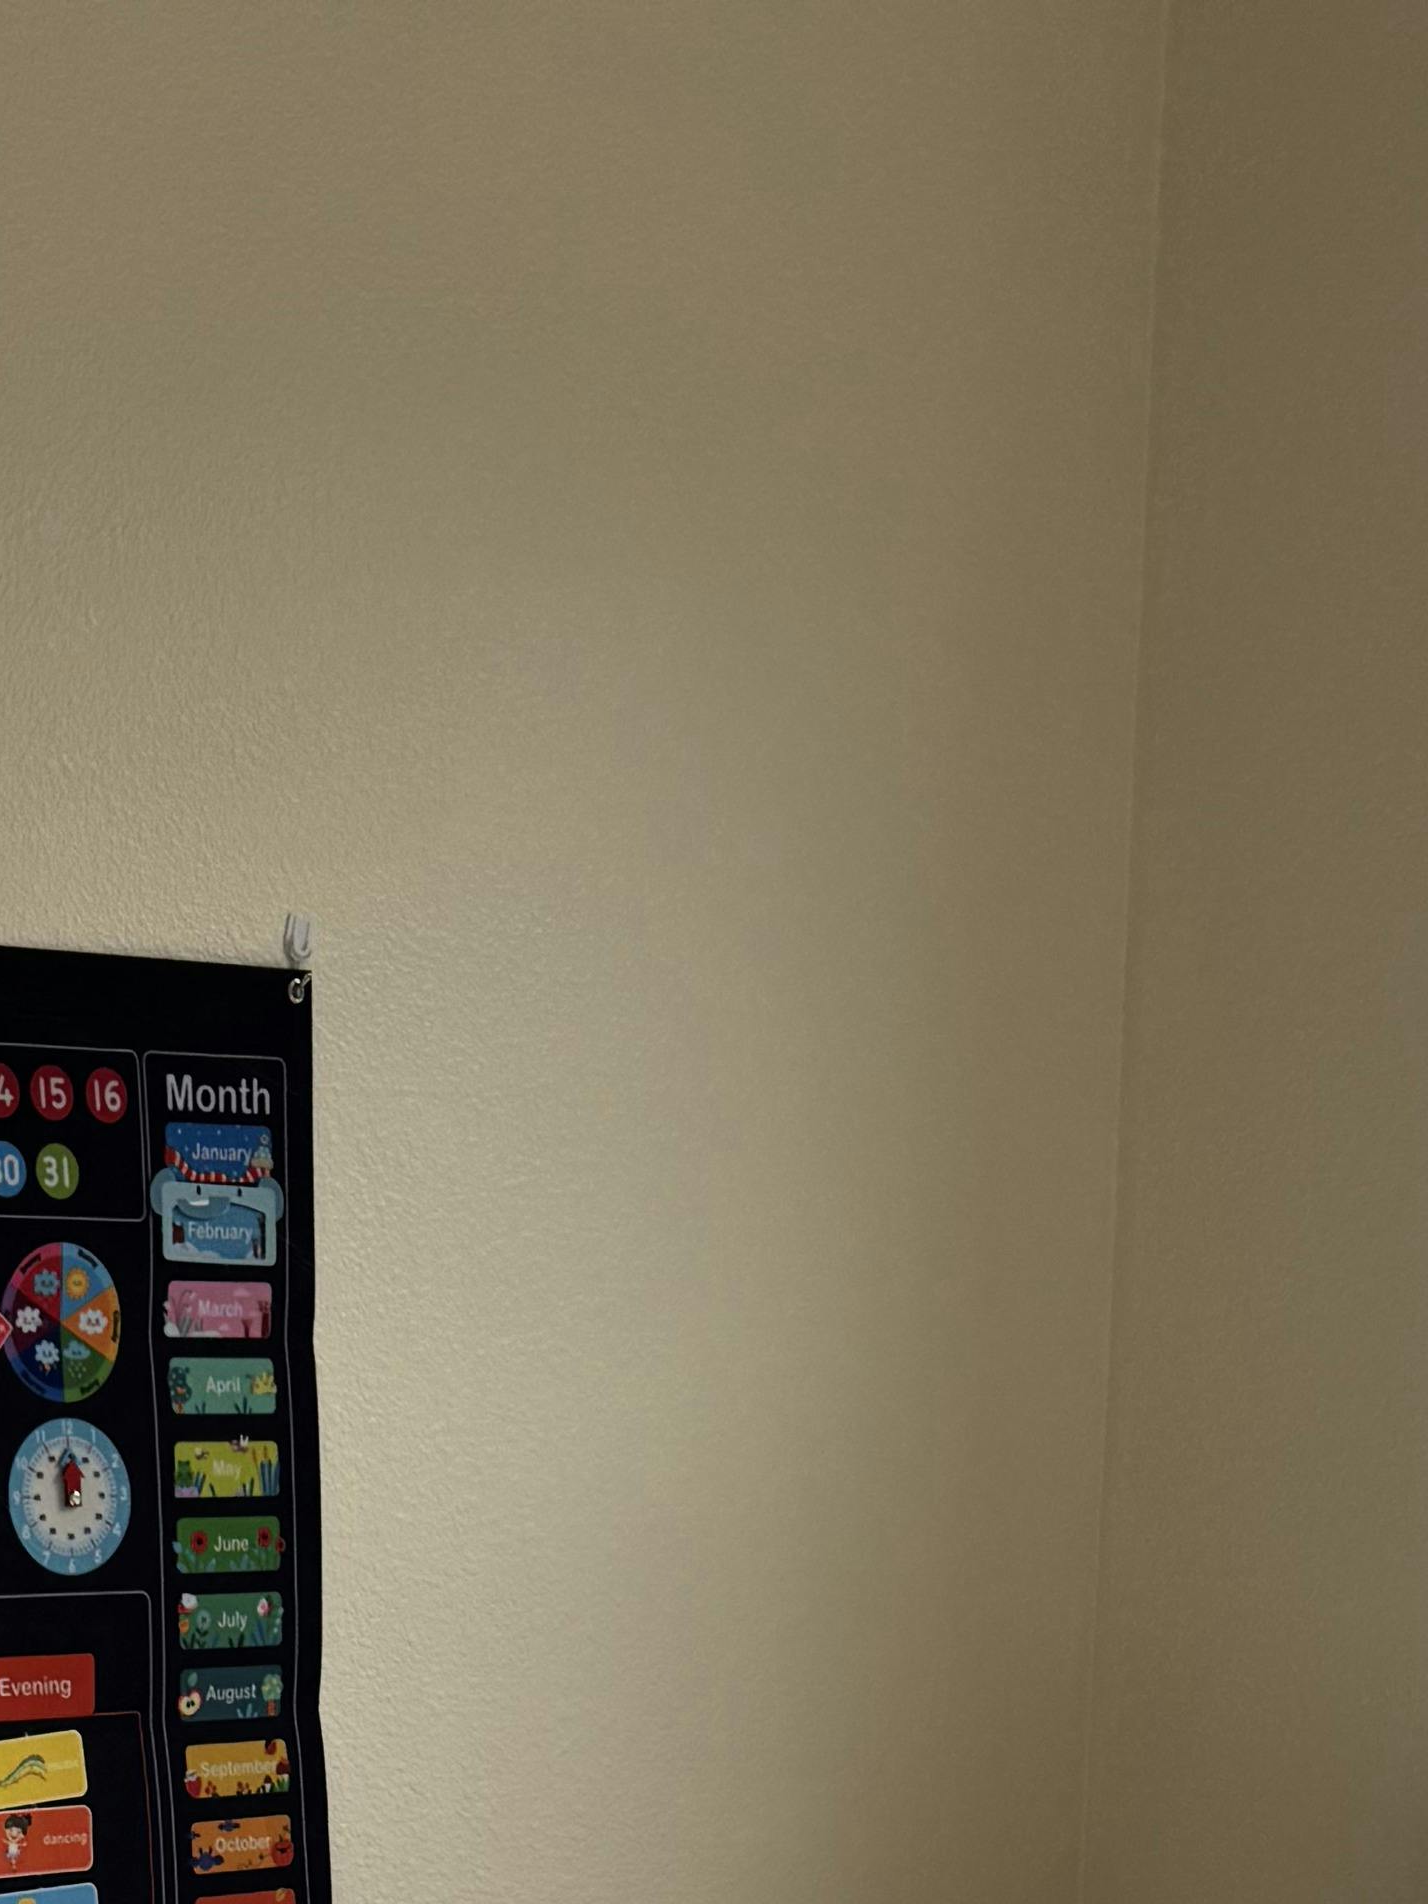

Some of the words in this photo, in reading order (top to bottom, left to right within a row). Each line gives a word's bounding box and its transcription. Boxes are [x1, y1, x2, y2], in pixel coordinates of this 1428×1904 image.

[38, 1075, 66, 1109] 15
[94, 1077, 121, 1112] 16
[166, 1073, 271, 1116] Month
[191, 1142, 252, 1166] January
[188, 1218, 253, 1244] February
[197, 1298, 243, 1318] March
[205, 1375, 242, 1396] April
[212, 1458, 241, 1481] May
[214, 1533, 250, 1555] June
[217, 1611, 248, 1633] July
[205, 1681, 258, 1705] August
[43, 1831, 88, 1847] dancing
[214, 1833, 271, 1853] October
